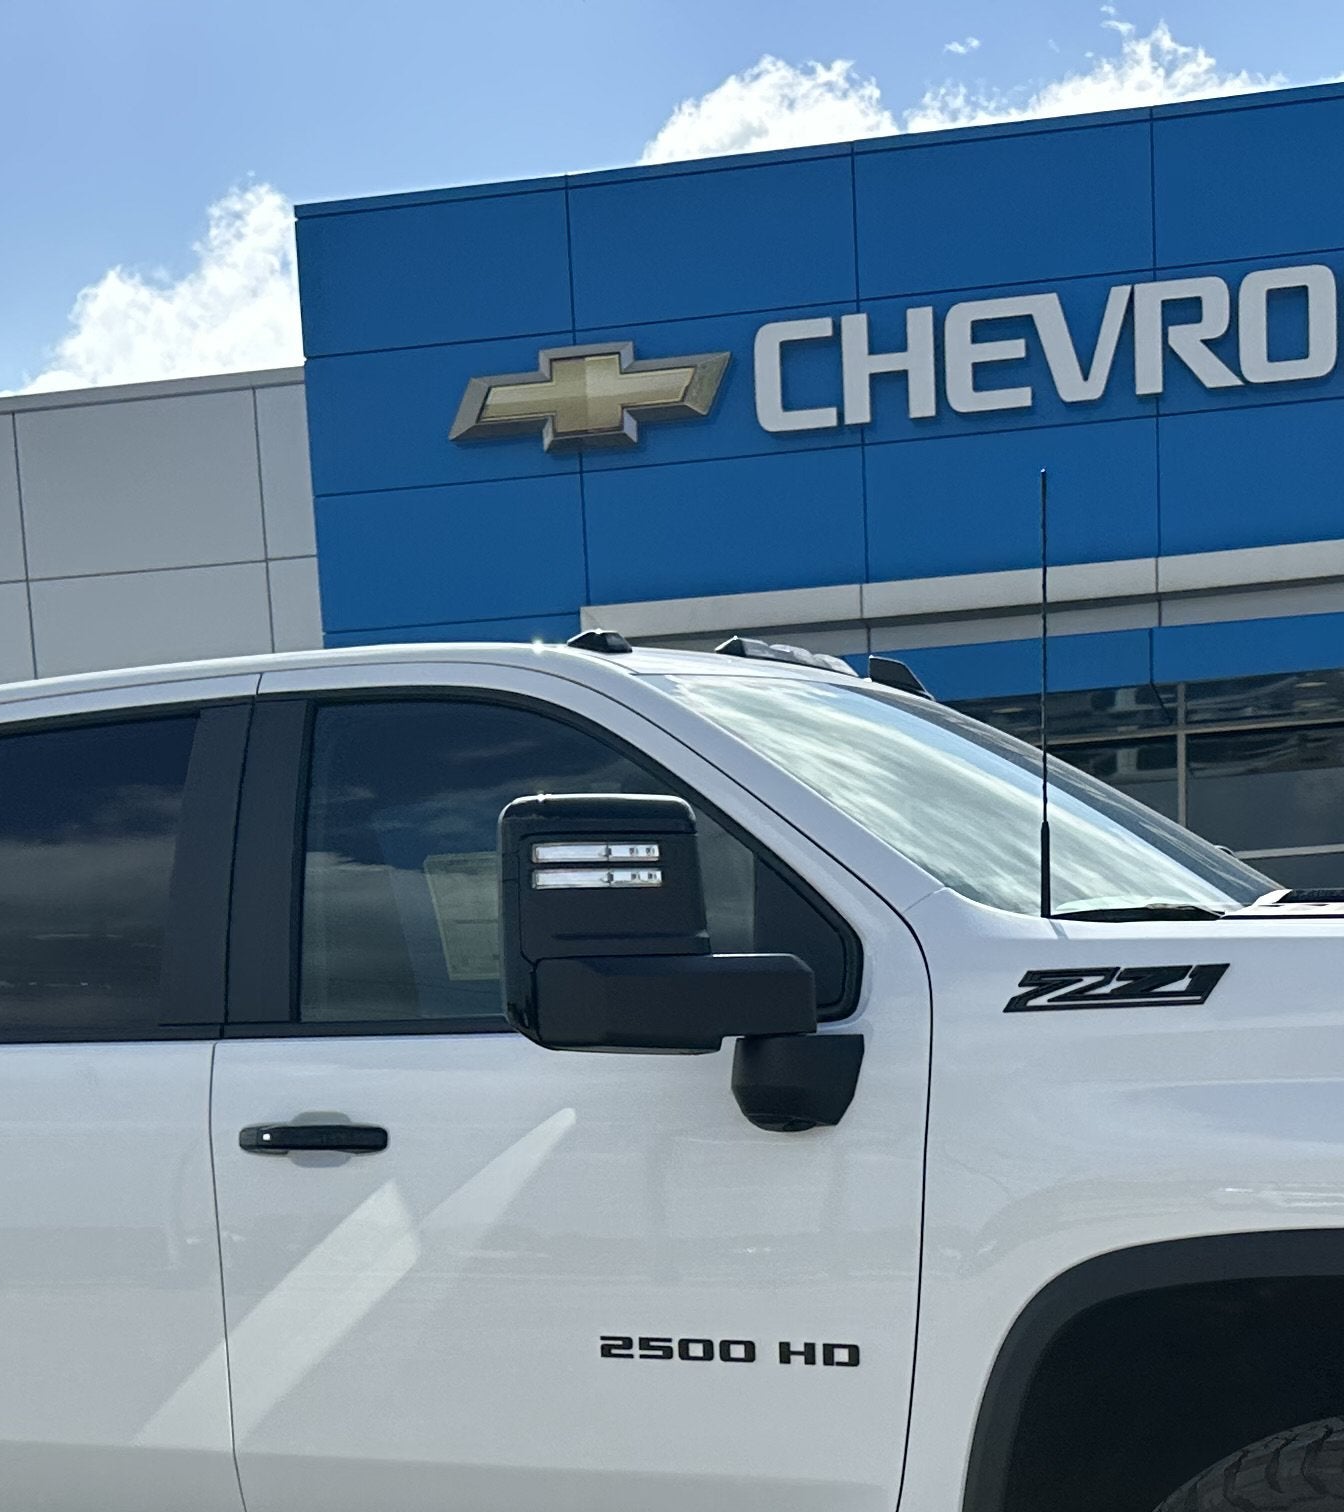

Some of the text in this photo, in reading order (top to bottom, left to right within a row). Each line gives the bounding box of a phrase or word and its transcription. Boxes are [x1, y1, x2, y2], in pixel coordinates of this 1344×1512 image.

[1003, 963, 1230, 1012] Z71
[600, 1335, 860, 1367] 2500 HD
